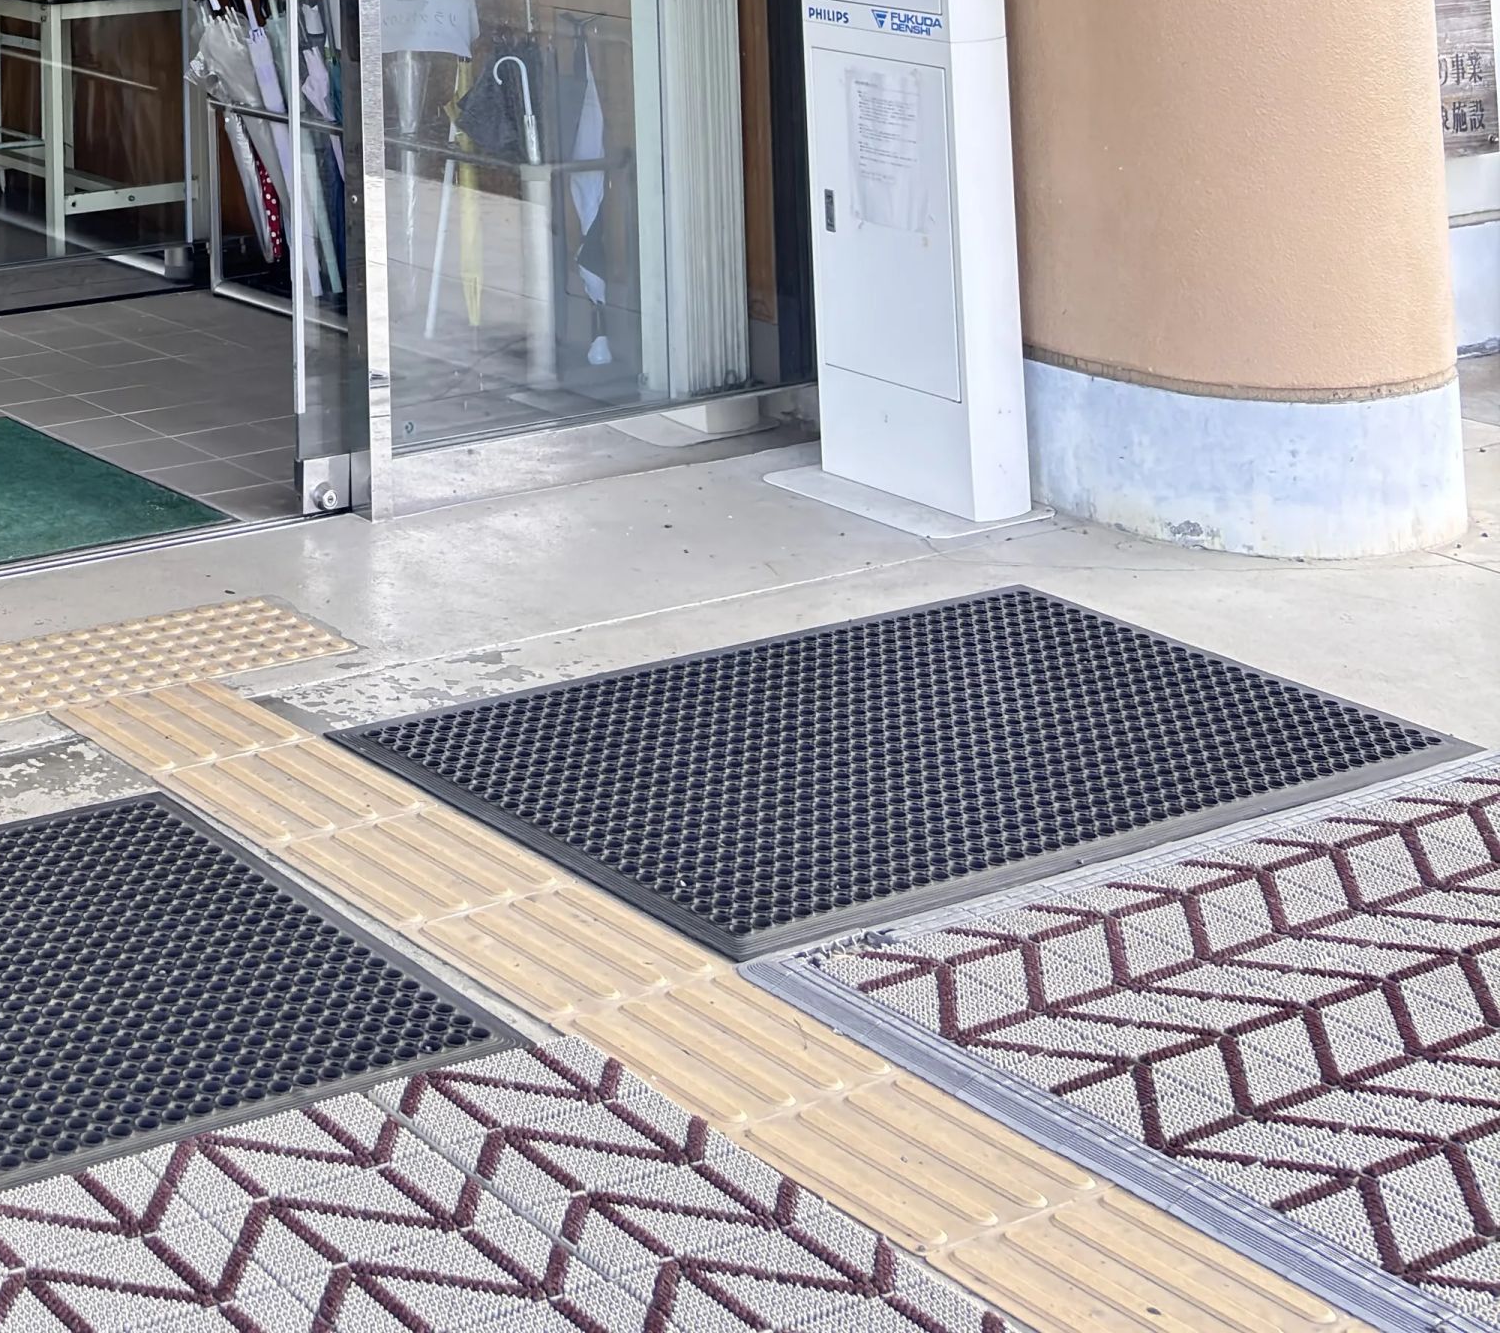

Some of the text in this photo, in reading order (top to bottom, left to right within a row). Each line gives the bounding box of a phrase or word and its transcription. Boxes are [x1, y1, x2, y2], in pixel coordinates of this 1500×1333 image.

[808, 6, 849, 24] PHILIPS
[890, 12, 942, 29] FUKUDA
[890, 22, 932, 36] DENSHI
